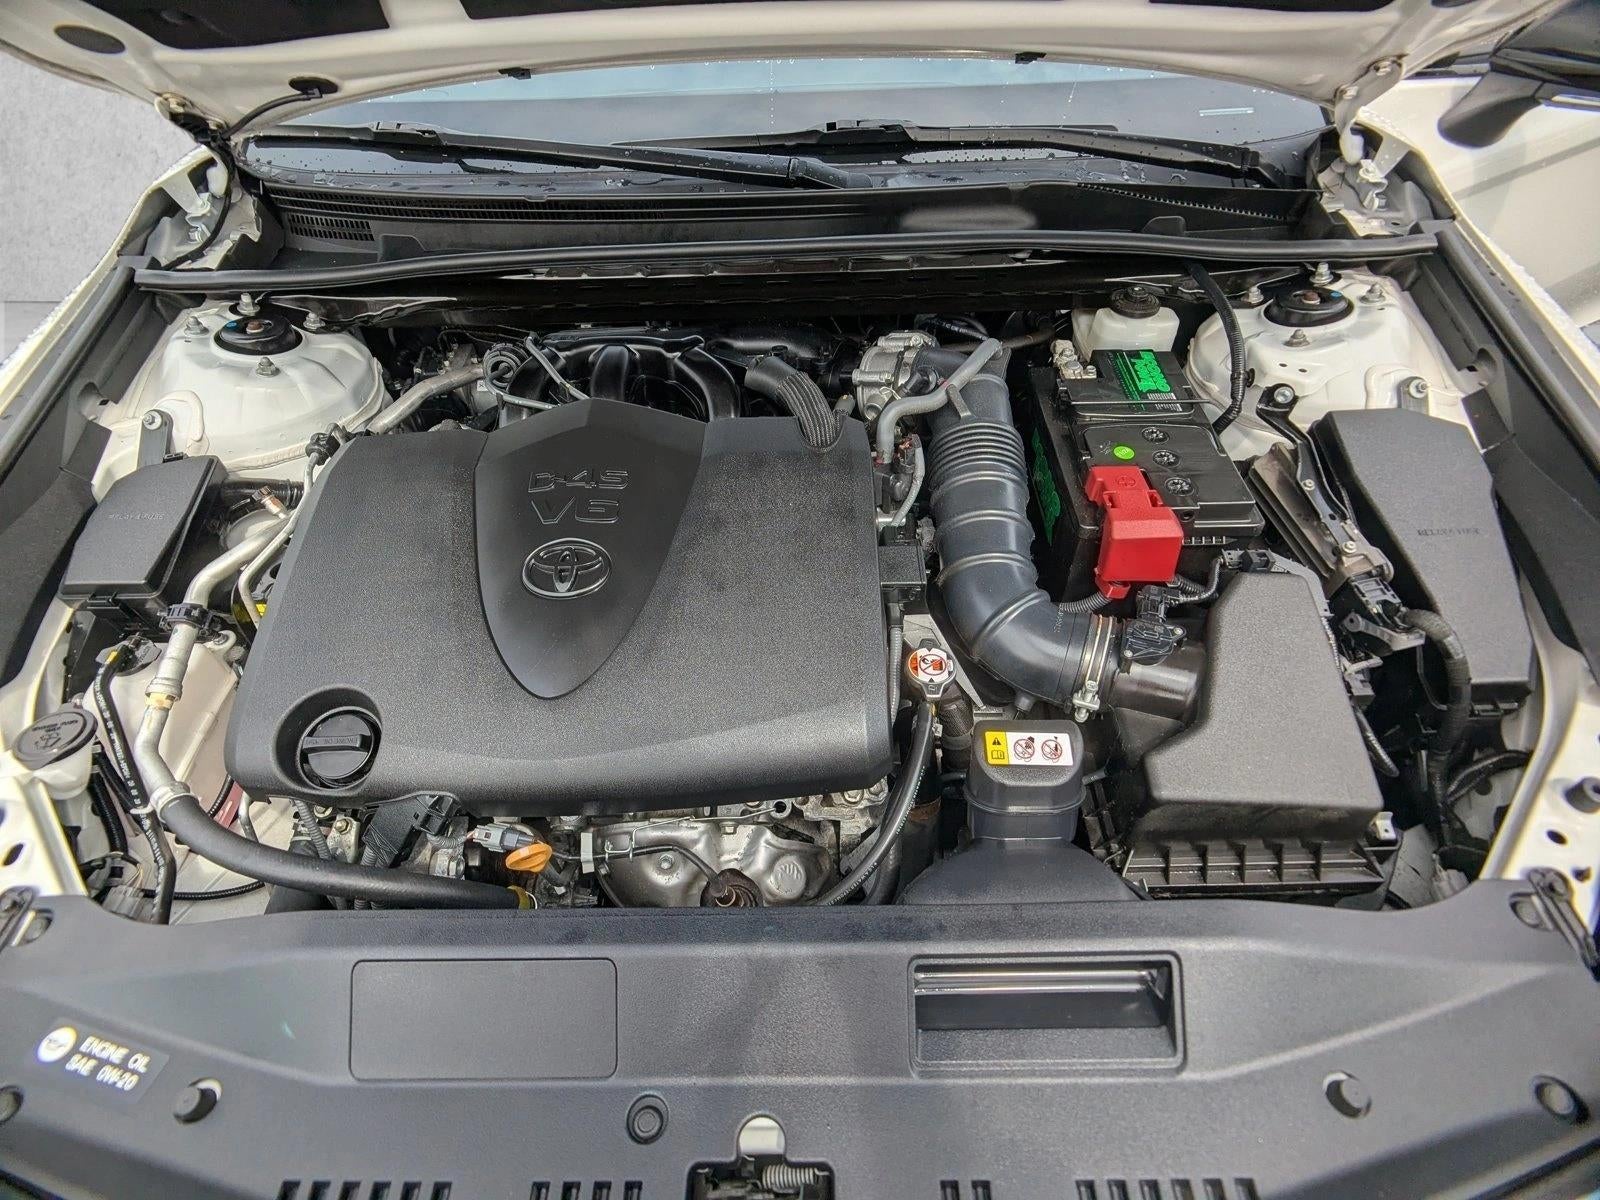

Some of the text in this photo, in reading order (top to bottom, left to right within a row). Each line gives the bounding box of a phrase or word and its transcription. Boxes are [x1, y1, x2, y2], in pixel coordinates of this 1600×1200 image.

[527, 469, 629, 493] D-4S
[530, 496, 620, 525] V6
[78, 1035, 151, 1074] ENGINE OIL
[65, 1053, 140, 1092] SAE 0W-20
